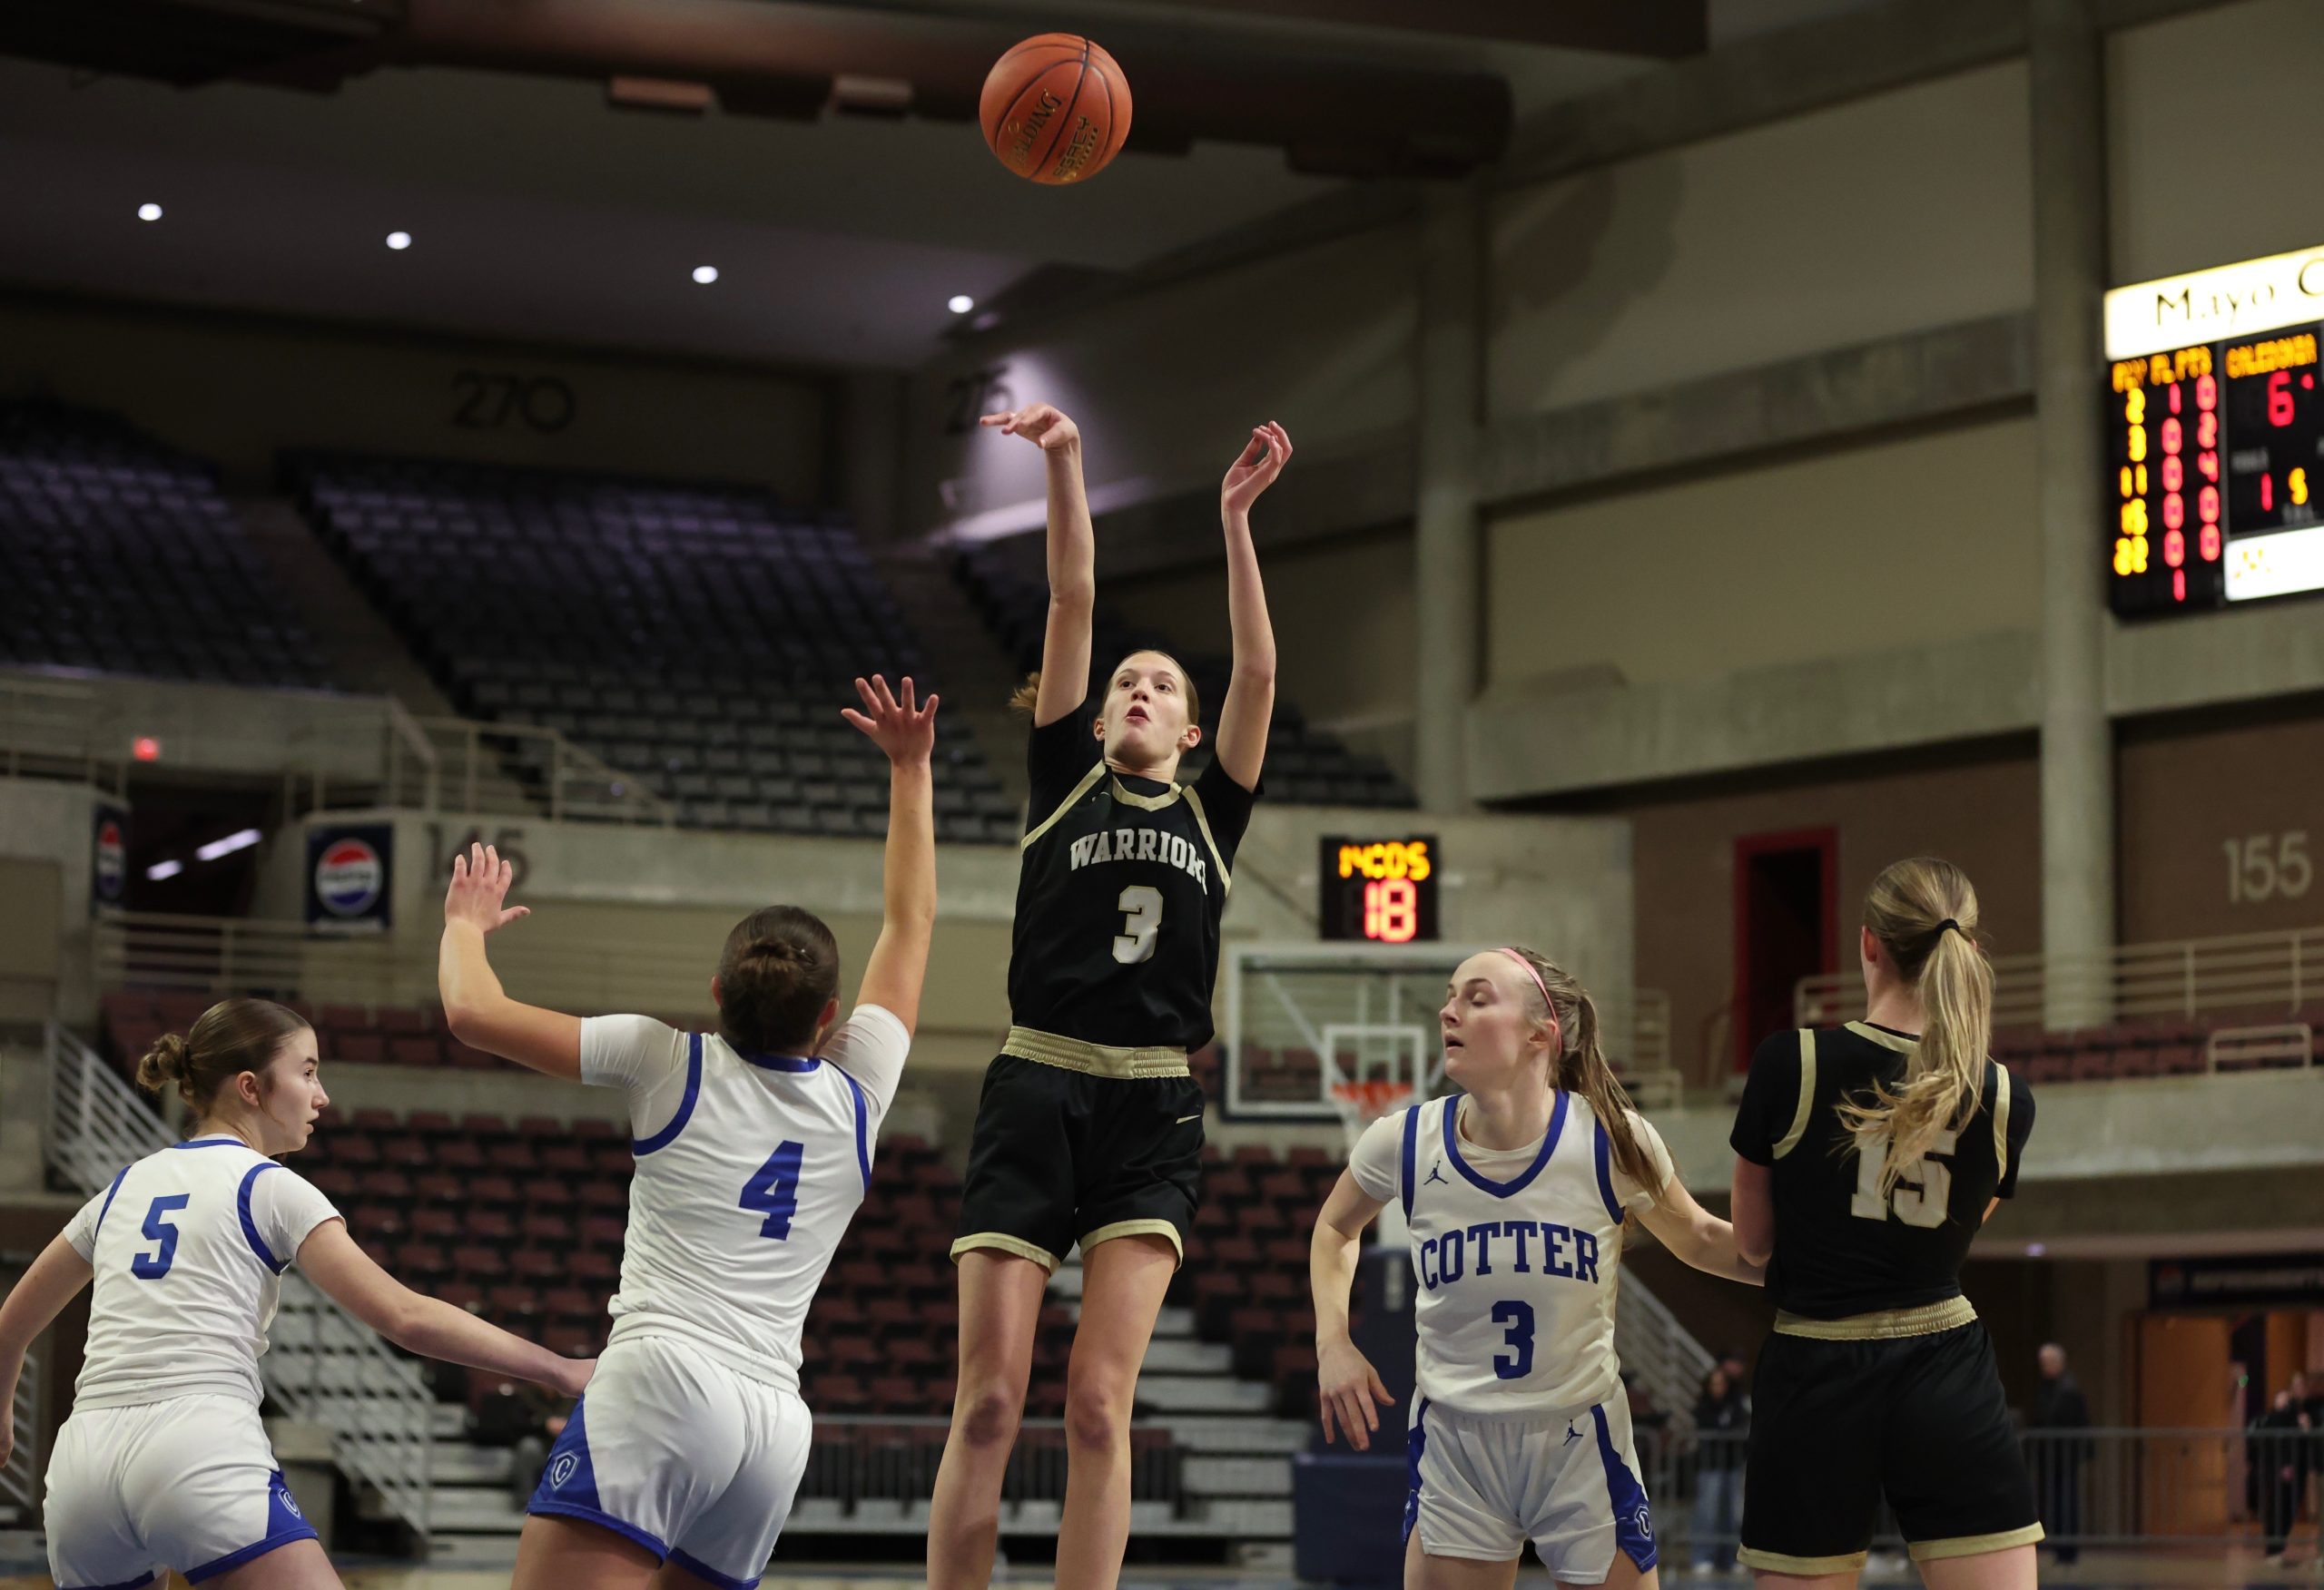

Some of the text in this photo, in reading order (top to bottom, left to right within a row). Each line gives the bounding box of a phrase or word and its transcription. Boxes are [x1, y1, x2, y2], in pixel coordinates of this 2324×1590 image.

[451, 368, 576, 434] 270
[2170, 382, 2181, 415] 1
[2120, 464, 2148, 497] 11
[1070, 828, 1208, 896] WARRIOR
[2221, 831, 2312, 903] 155
[1112, 885, 1164, 964] 3
[1364, 878, 1416, 943] 18
[738, 1140, 804, 1242] 4
[1850, 1120, 1958, 1230] 15
[130, 1192, 191, 1281] 5
[1420, 1221, 1600, 1291] COTTER
[1492, 1300, 1535, 1380] 3
[555, 1458, 571, 1483] C
